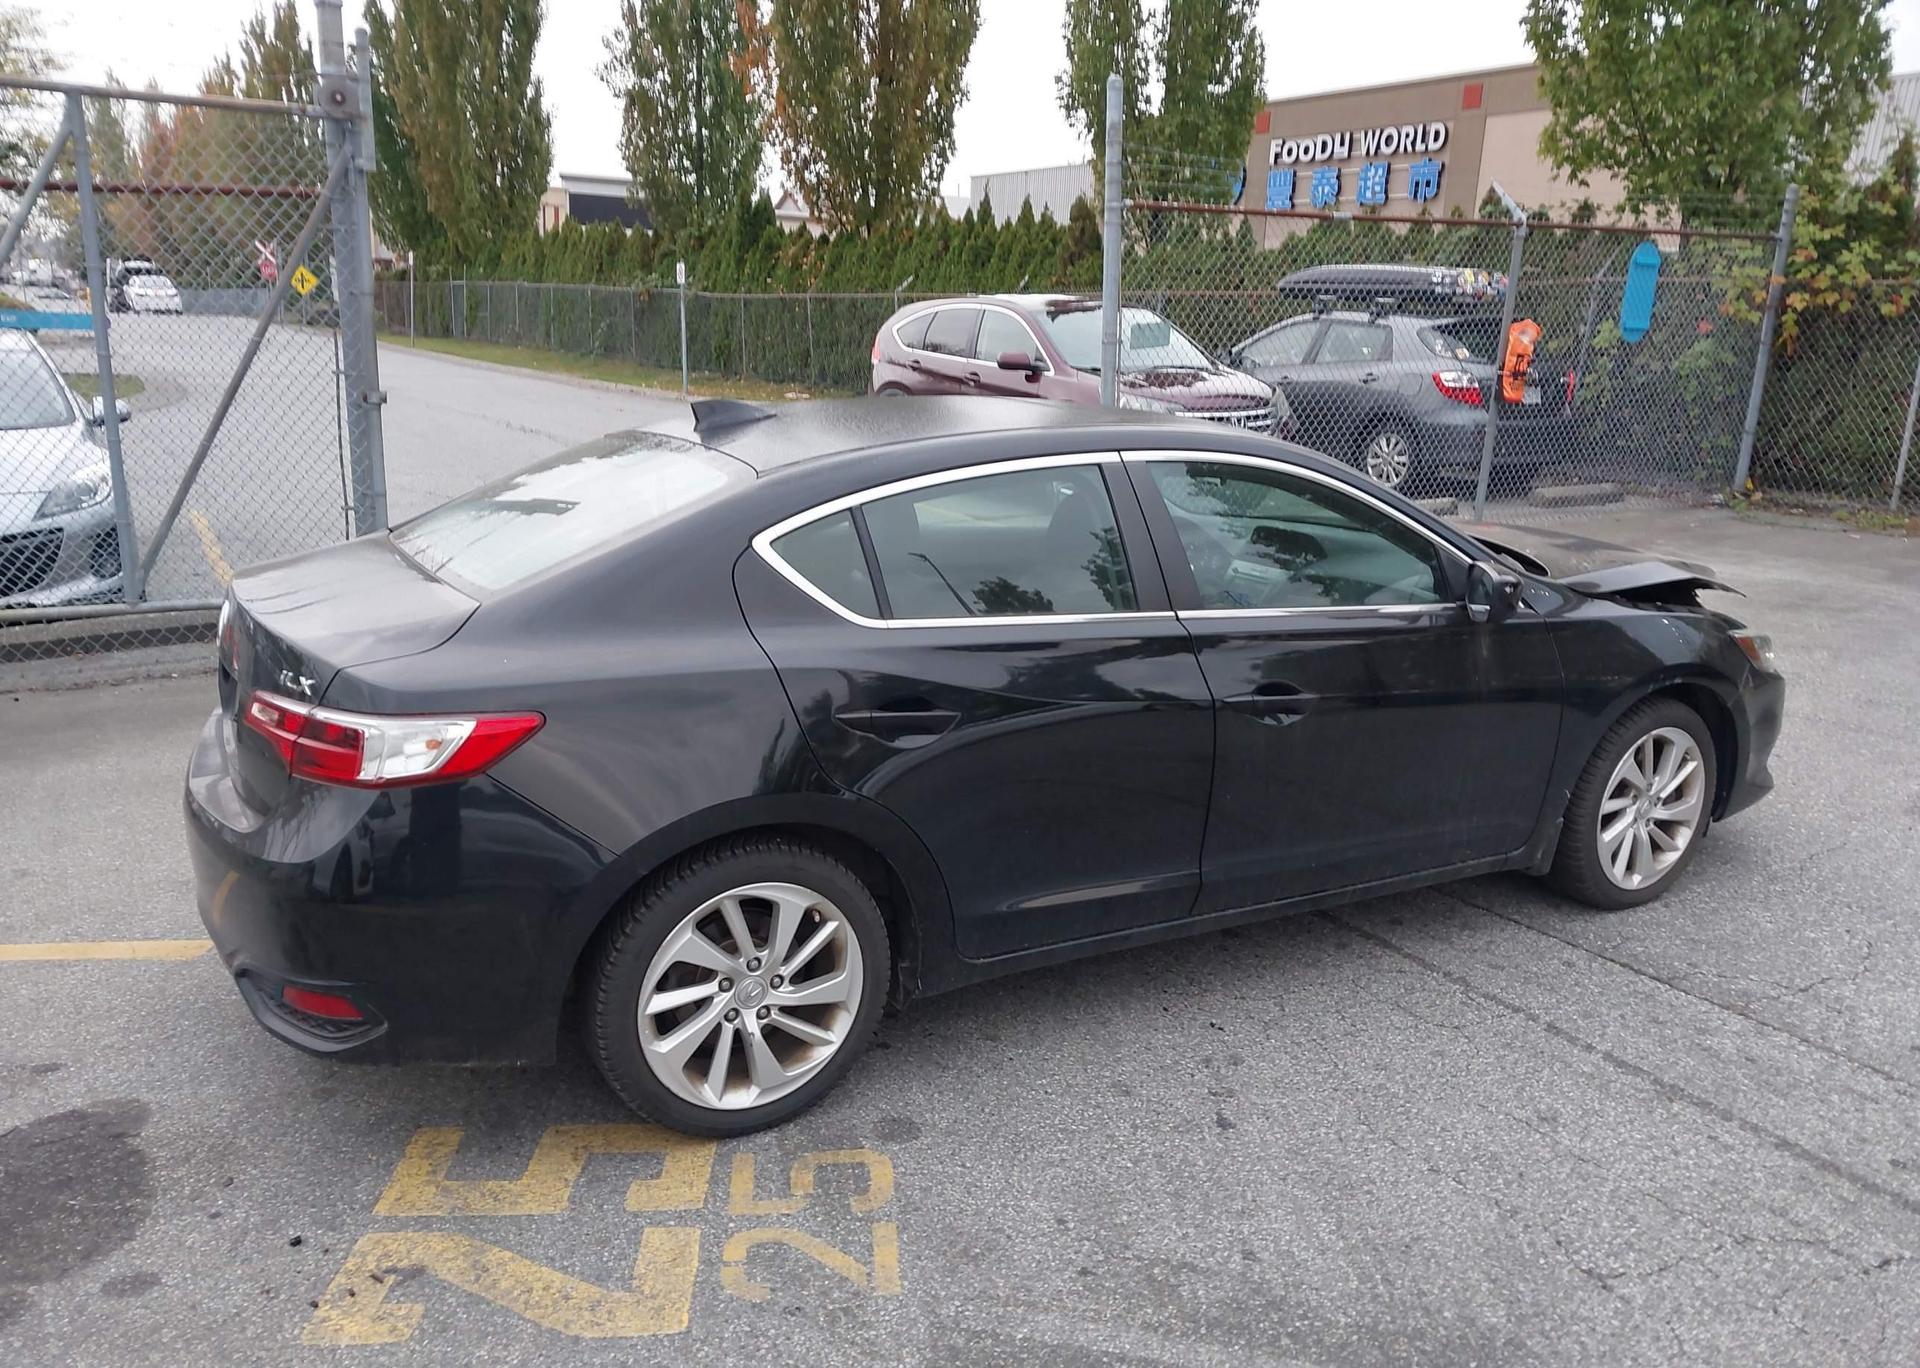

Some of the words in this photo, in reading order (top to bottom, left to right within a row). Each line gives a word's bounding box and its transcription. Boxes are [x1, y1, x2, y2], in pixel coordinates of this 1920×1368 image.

[1360, 121, 1447, 157] WORLD
[280, 669, 316, 696] ILX
[301, 1125, 717, 1345] 25
[720, 1149, 901, 1301] 25
